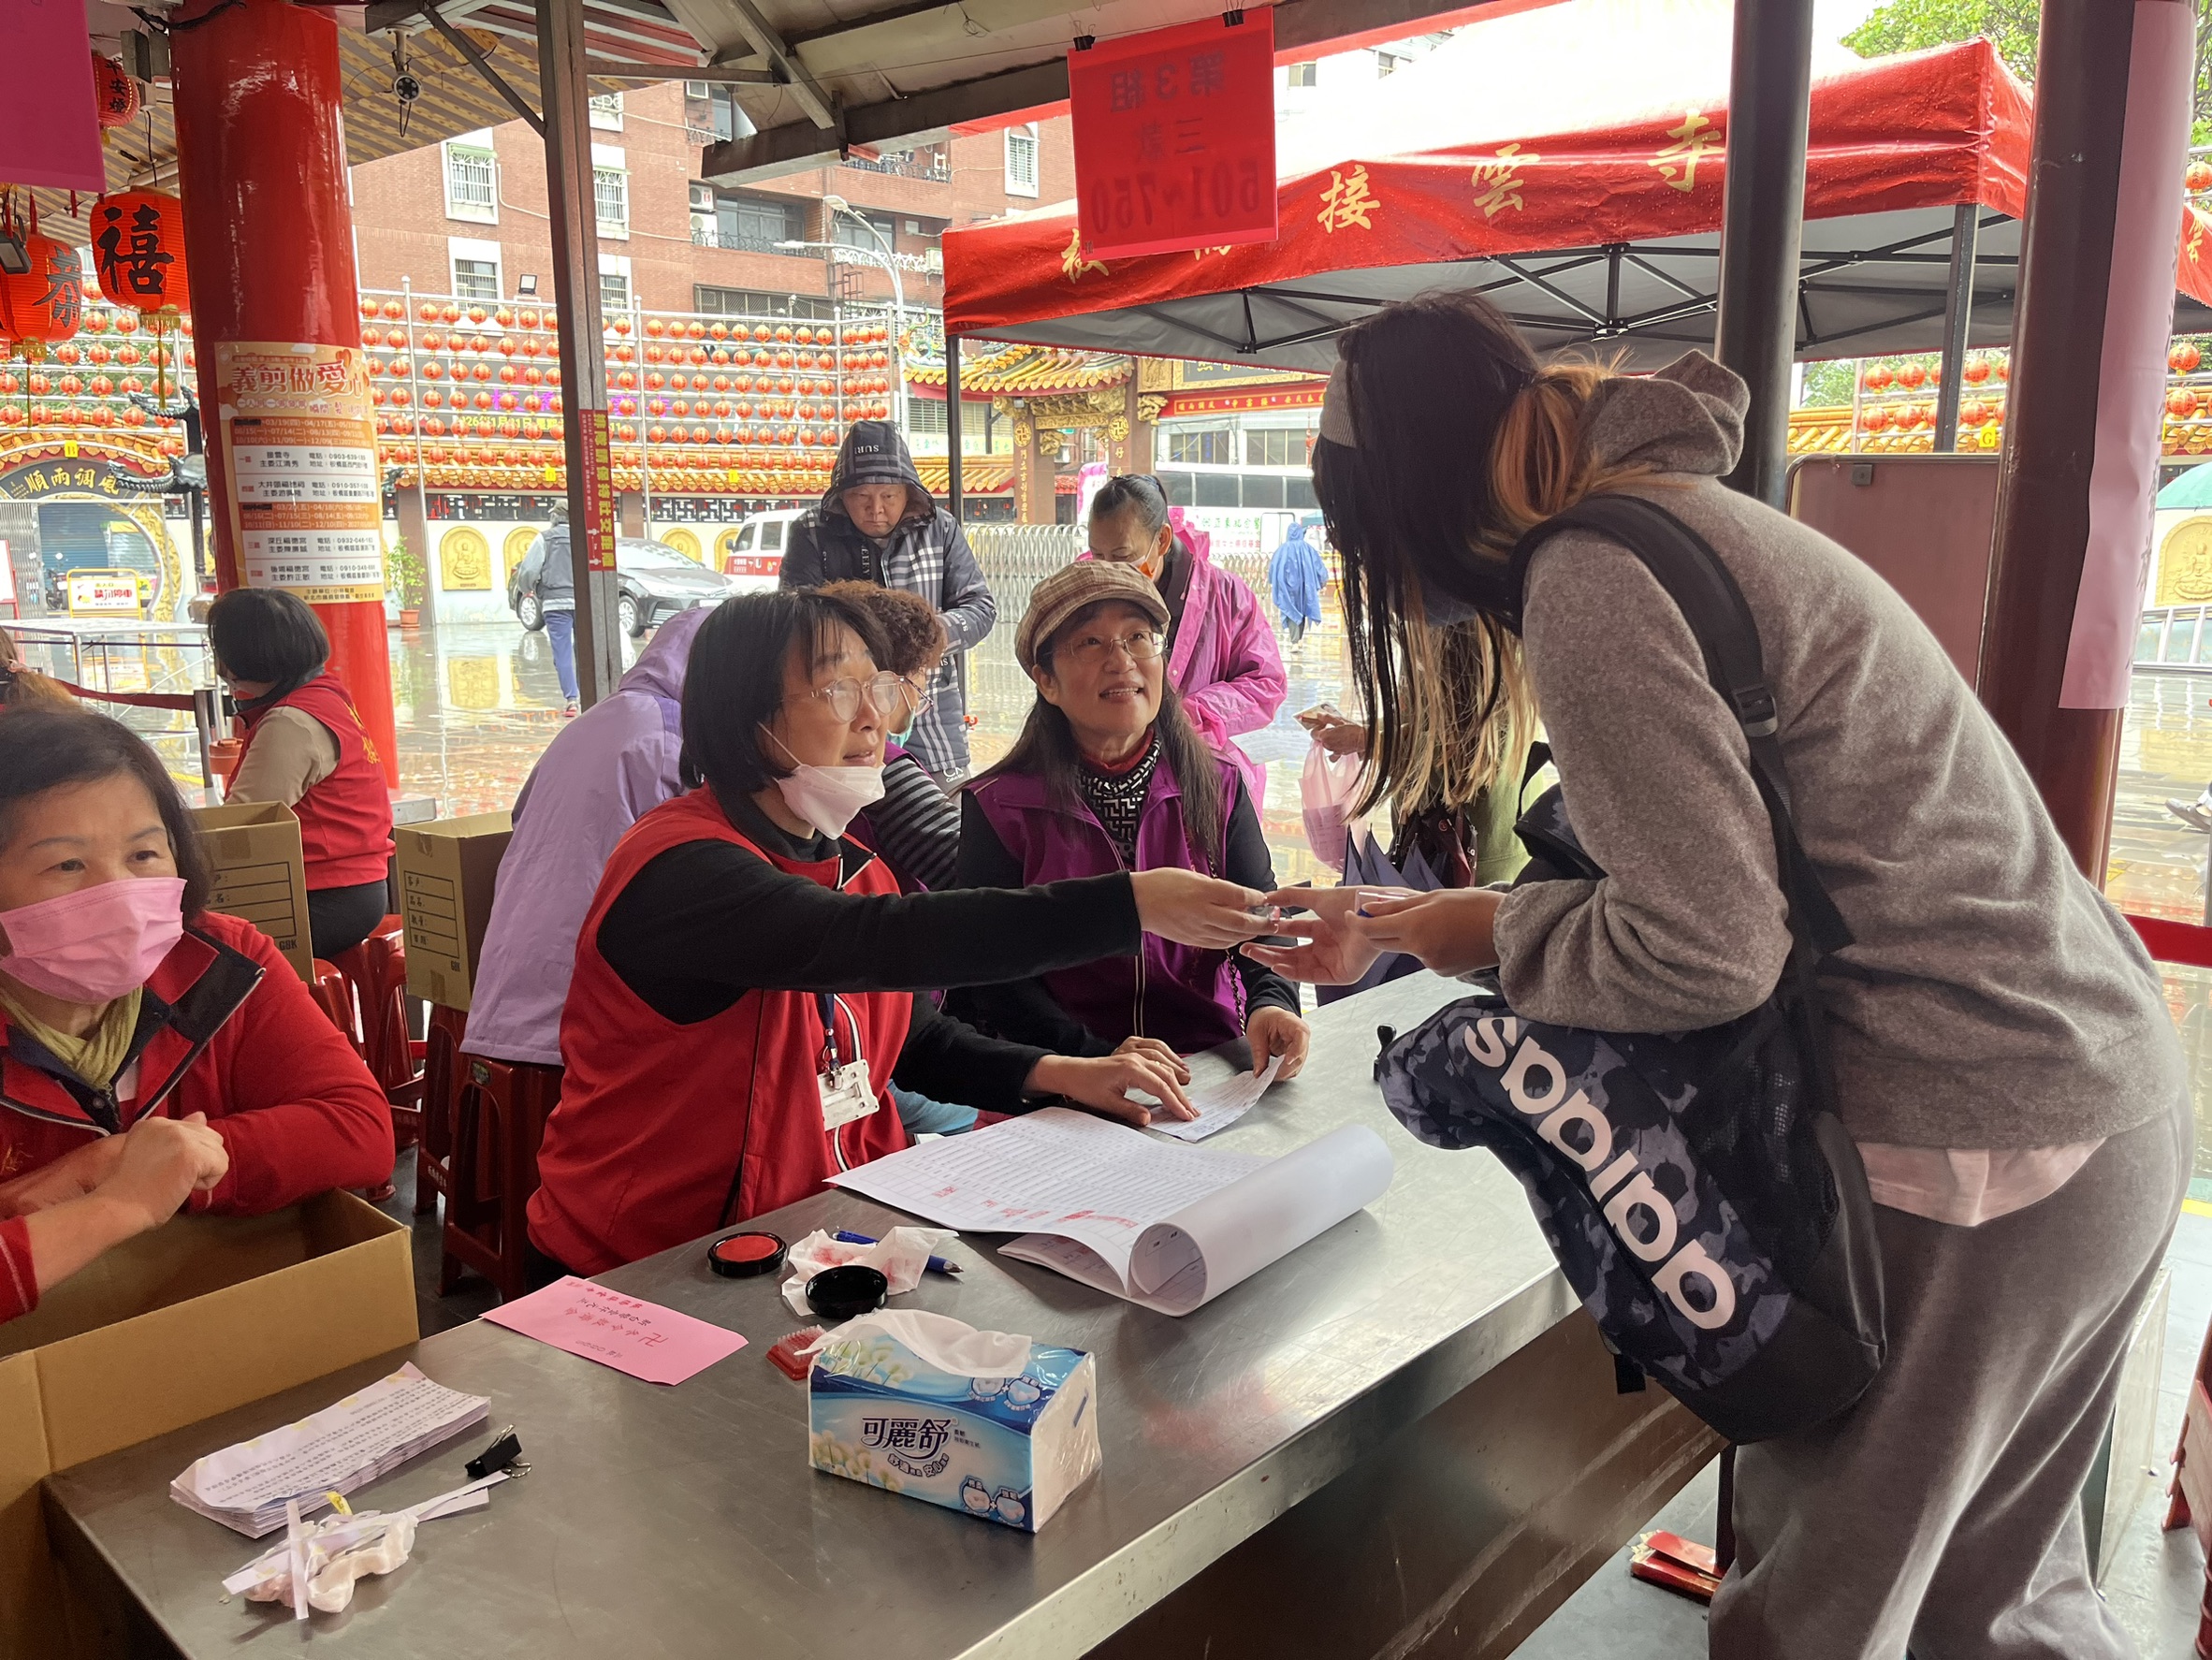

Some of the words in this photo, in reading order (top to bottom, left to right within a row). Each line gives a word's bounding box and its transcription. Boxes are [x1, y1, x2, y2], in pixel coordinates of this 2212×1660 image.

[96, 203, 175, 295] 禧
[232, 360, 363, 398] 義剪做愛心
[1983, 430, 1992, 444] G
[593, 414, 615, 567] 排隊請保持社交距離
[860, 1417, 952, 1452] 可麗舒
